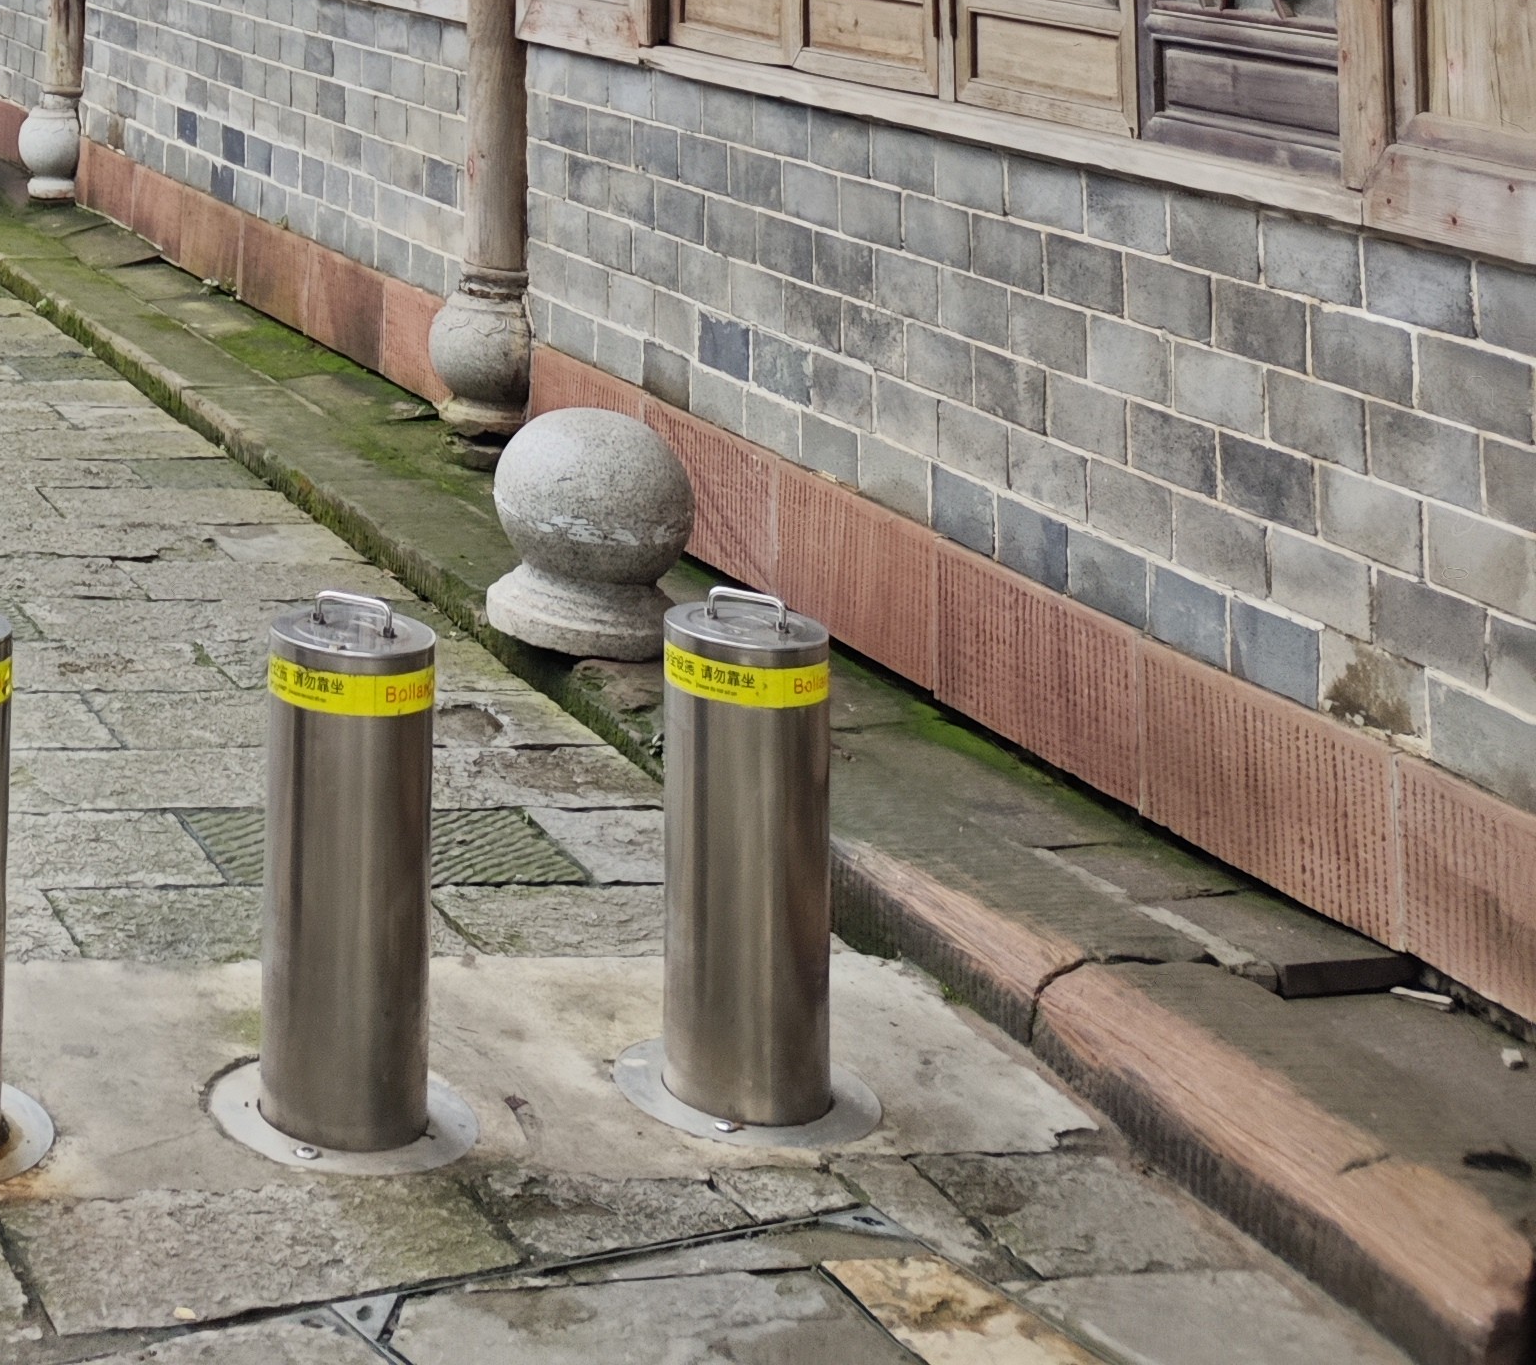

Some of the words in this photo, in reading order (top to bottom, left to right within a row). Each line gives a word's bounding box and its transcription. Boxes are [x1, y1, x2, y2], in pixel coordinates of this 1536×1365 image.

[293, 670, 345, 695] 请勿靠坐
[700, 663, 756, 689] 请勿靠坐
